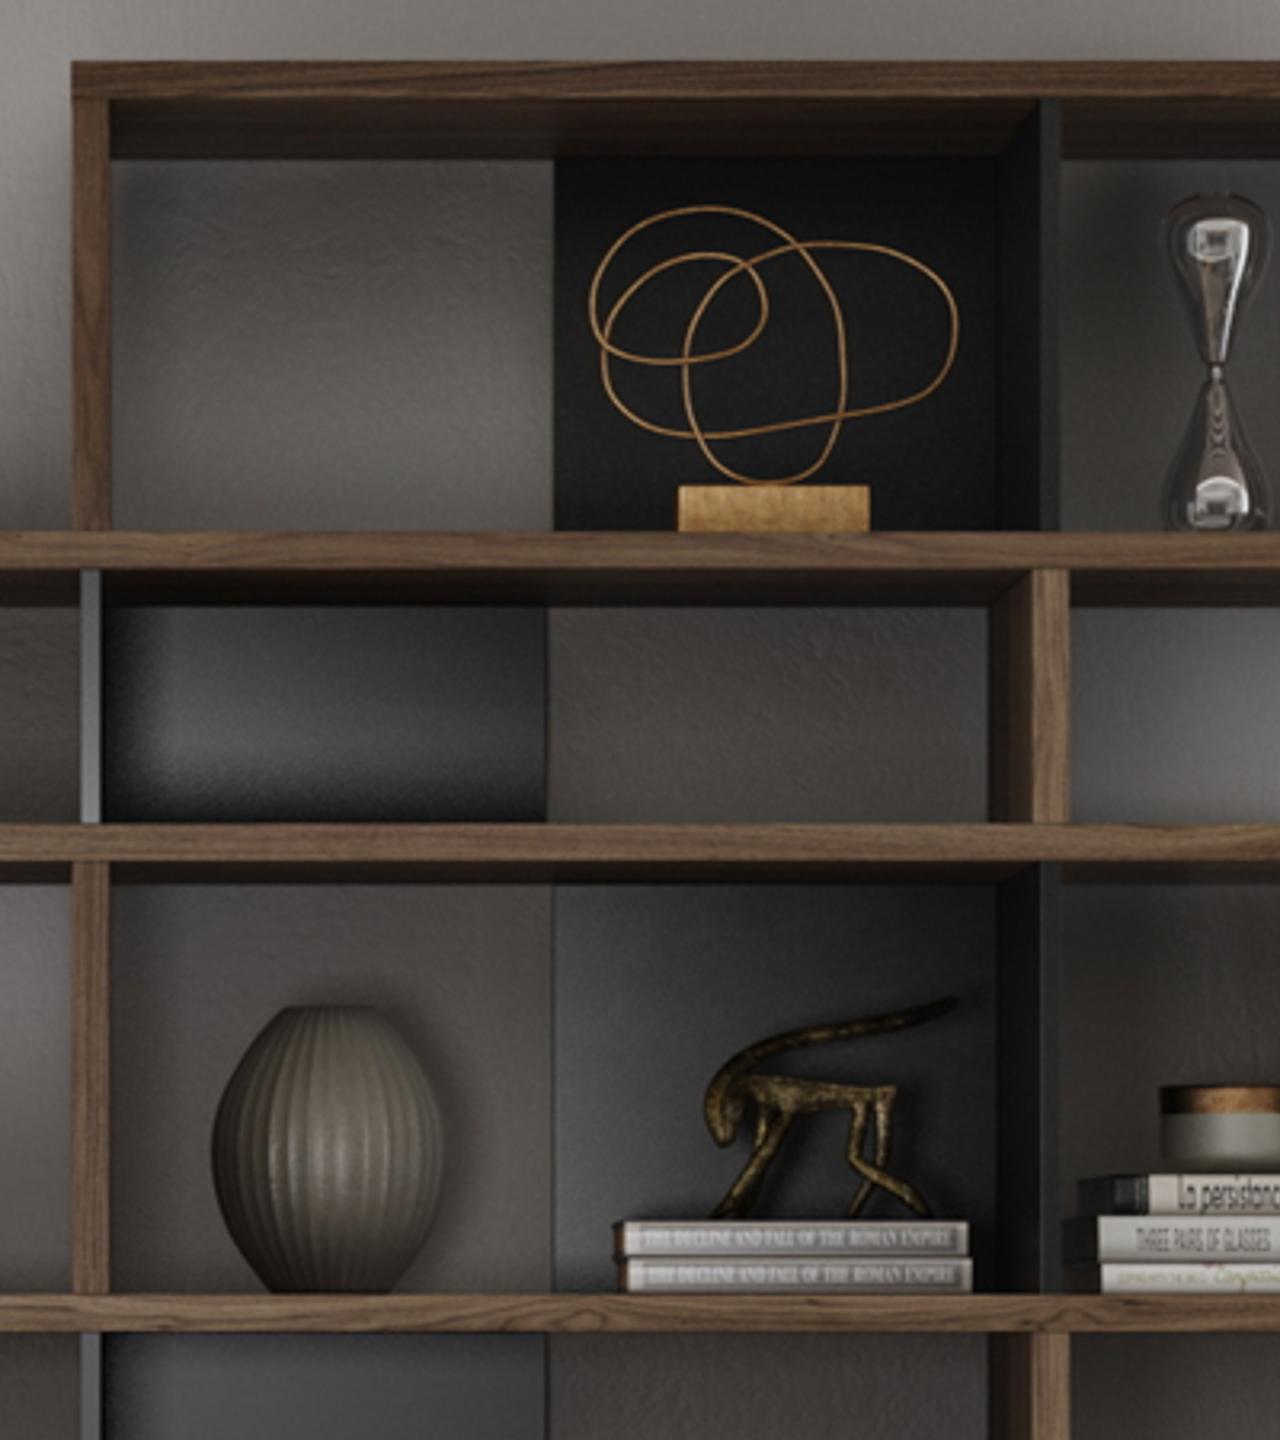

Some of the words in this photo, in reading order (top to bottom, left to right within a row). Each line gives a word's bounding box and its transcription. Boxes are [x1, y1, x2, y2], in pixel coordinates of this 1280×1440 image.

[797, 1229, 818, 1248] OF
[1206, 1227, 1220, 1252] OF
[1224, 1227, 1271, 1252] GLASSES
[802, 1265, 823, 1285] OF
